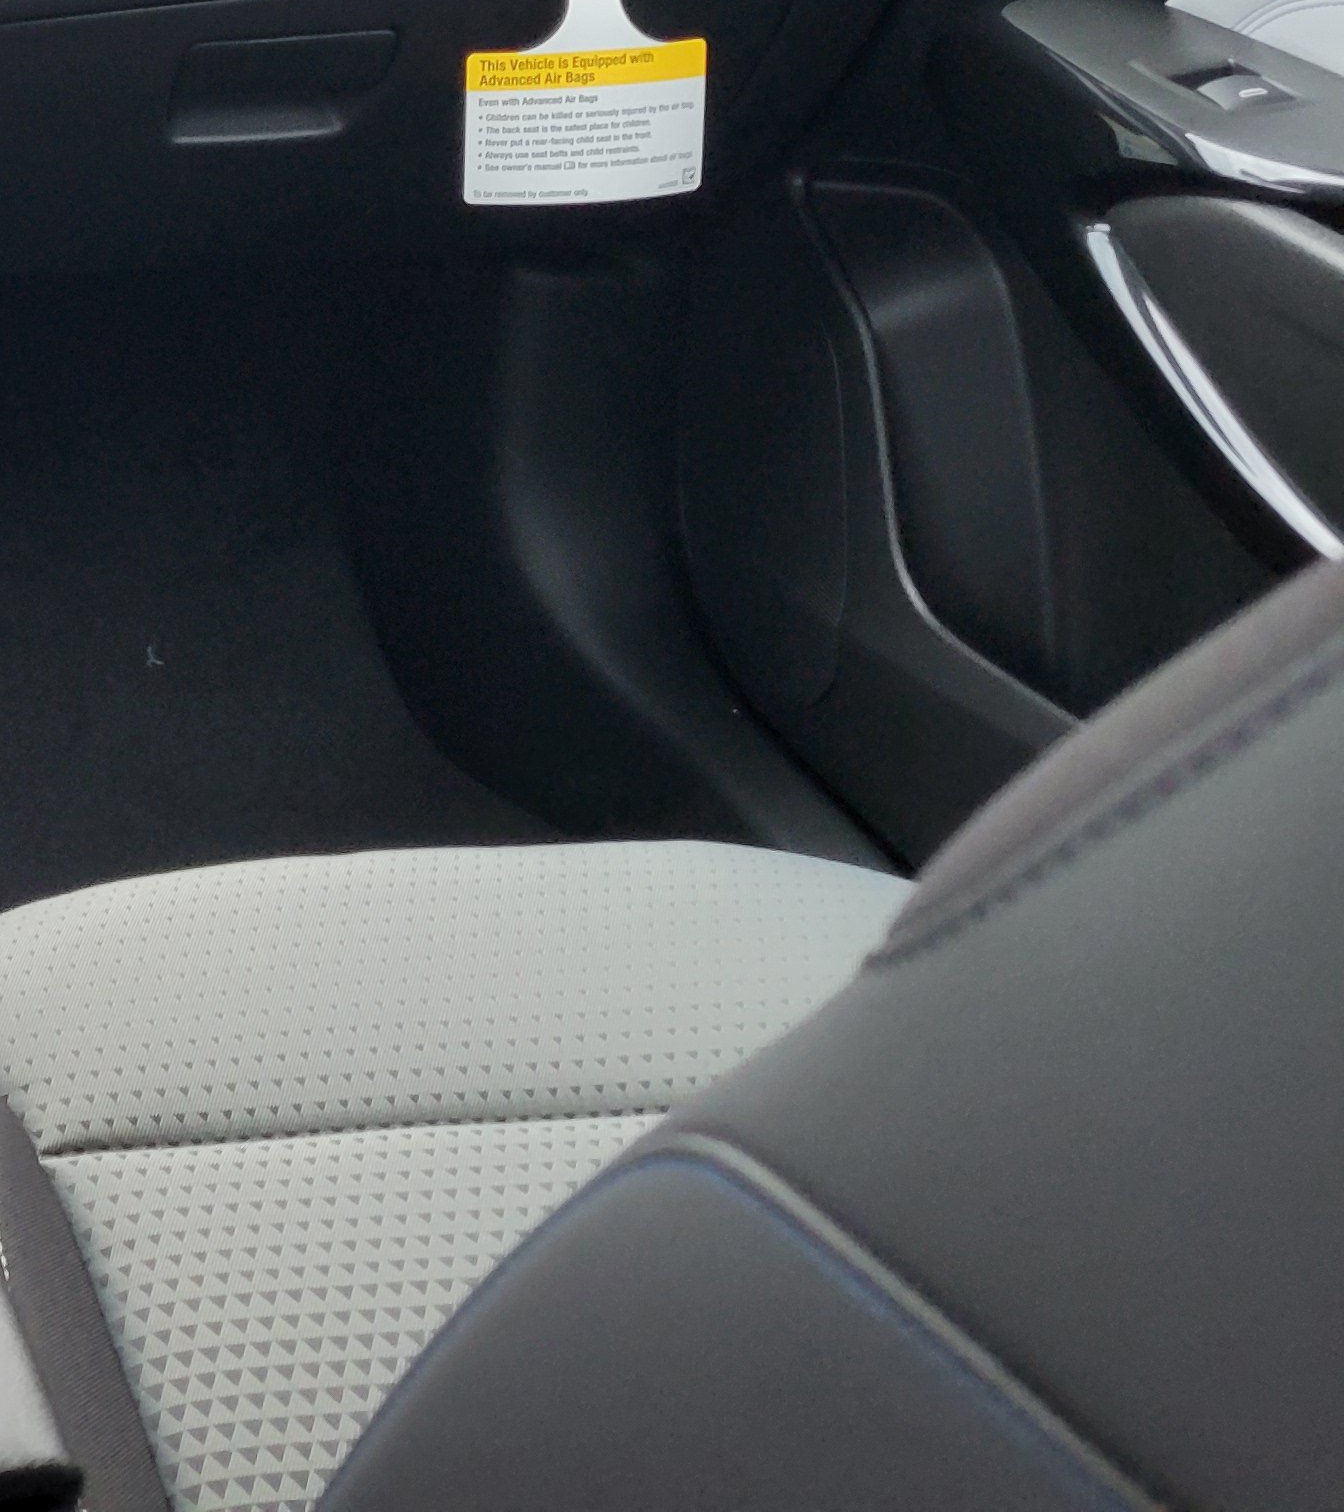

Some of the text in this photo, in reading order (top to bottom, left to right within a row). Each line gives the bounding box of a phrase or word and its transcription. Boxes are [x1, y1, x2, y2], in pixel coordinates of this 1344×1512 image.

[480, 52, 654, 72] This Vehicle is Equipped with
[480, 71, 595, 87] Advanced Air Bags
[478, 95, 598, 107] Even with Advanced Air Bags
[486, 113, 520, 121] Children
[551, 111, 573, 119] killed
[486, 126, 500, 134] The
[502, 126, 520, 134] back
[523, 126, 539, 134] seat
[550, 124, 562, 133] the
[564, 124, 587, 132] safest
[589, 123, 608, 132] place
[611, 121, 620, 129] for
[485, 139, 508, 147] Never
[510, 139, 523, 148] put
[532, 137, 574, 147] rear-facing
[576, 135, 594, 144] child
[596, 134, 611, 143] seat
[622, 133, 633, 141] the
[485, 151, 513, 160] Always
[550, 150, 568, 158] belts
[570, 149, 584, 157] and
[586, 148, 604, 156] child
[485, 163, 499, 171] See
[501, 163, 532, 172] owner's
[534, 163, 562, 171] manual
[578, 161, 588, 169] for
